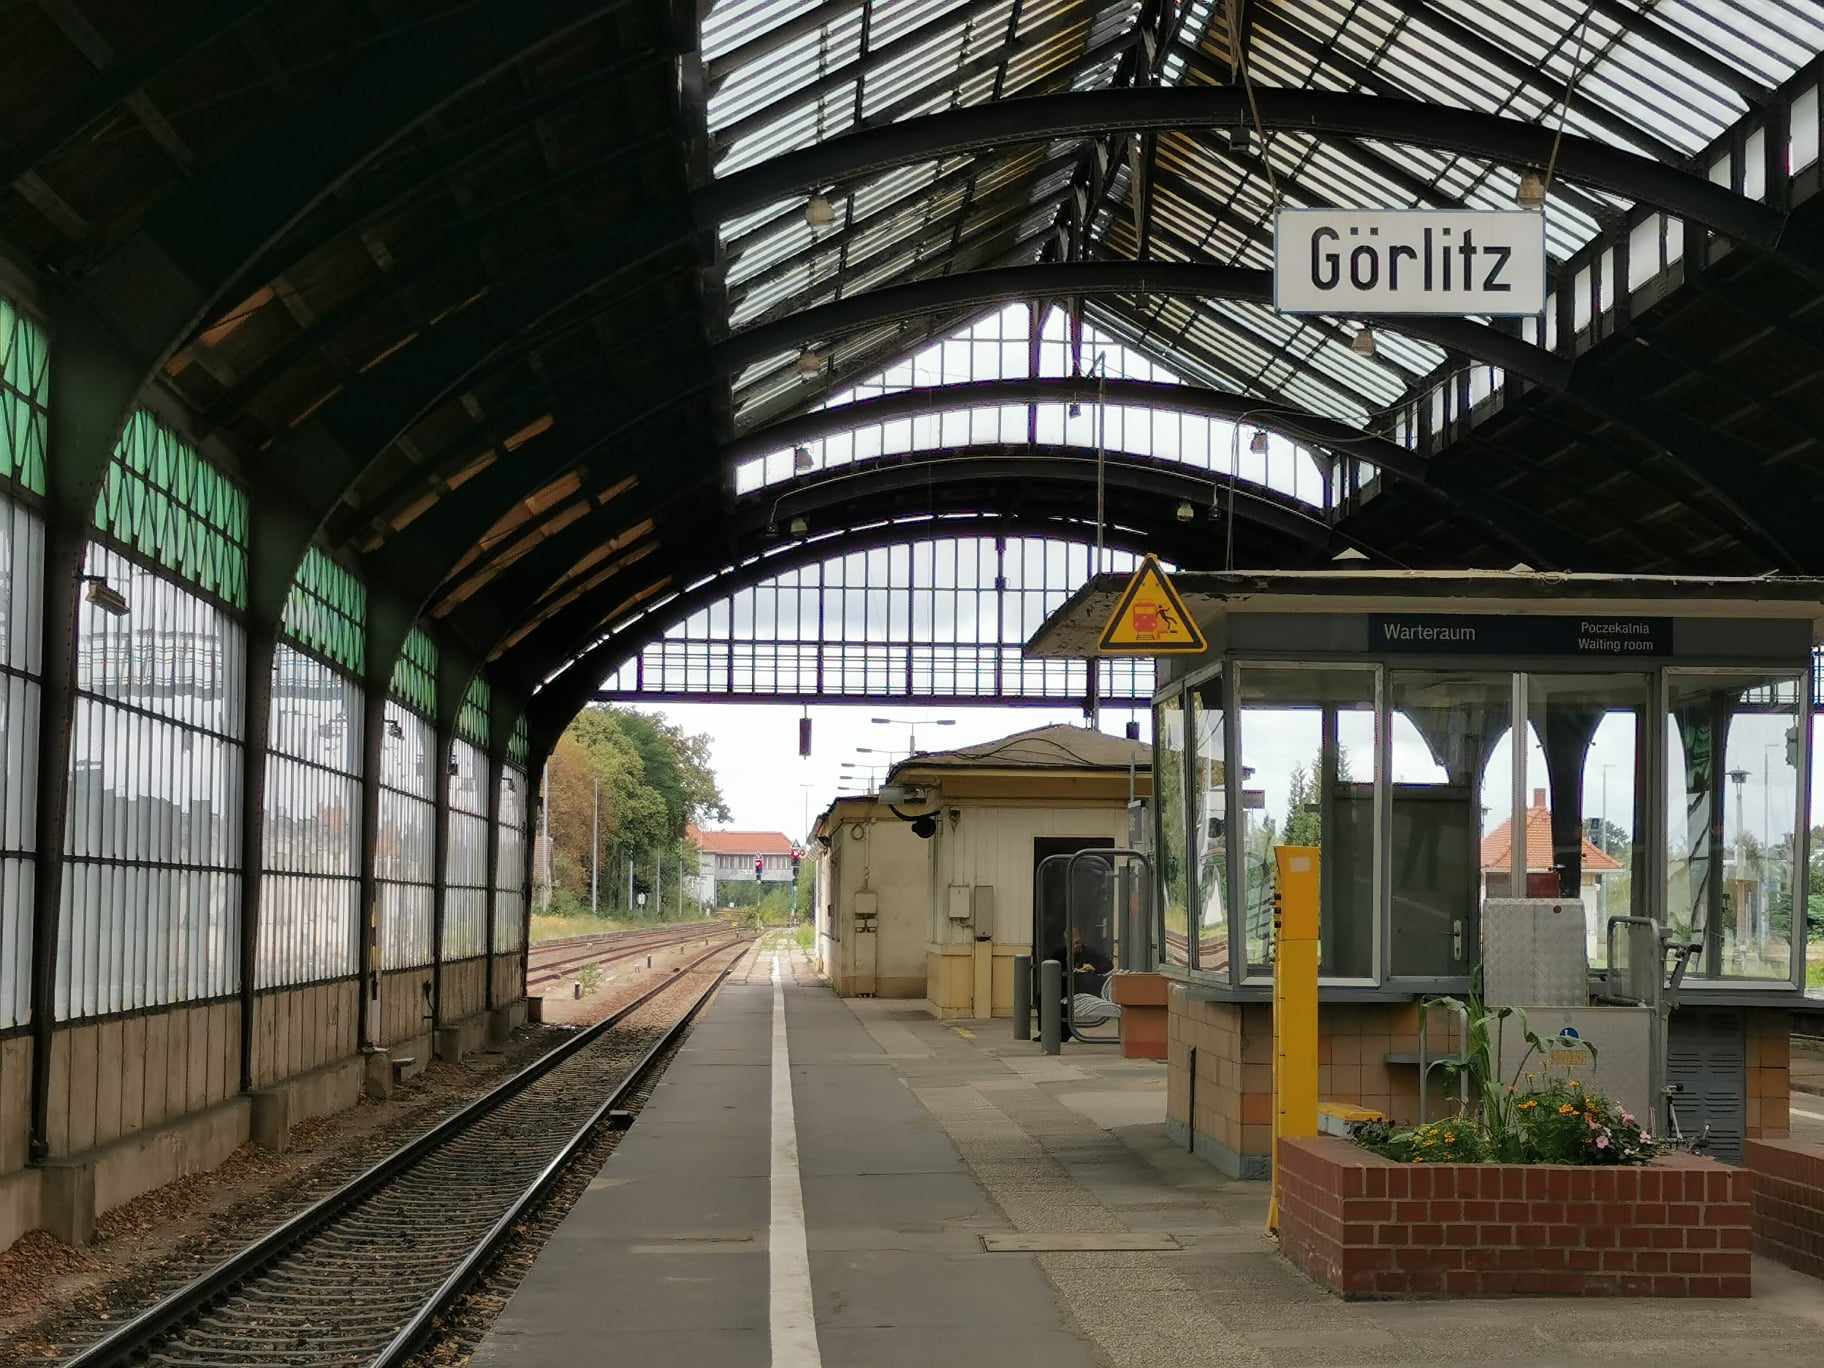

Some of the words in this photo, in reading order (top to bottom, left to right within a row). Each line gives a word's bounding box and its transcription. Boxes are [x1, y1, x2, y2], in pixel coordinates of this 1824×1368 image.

[1311, 226, 1512, 292] Görlitz
[1384, 623, 1476, 641] Warteraum
[1581, 622, 1650, 634] Poczekalnia
[1579, 639, 1620, 652] Waiting
[1624, 640, 1654, 651] room
